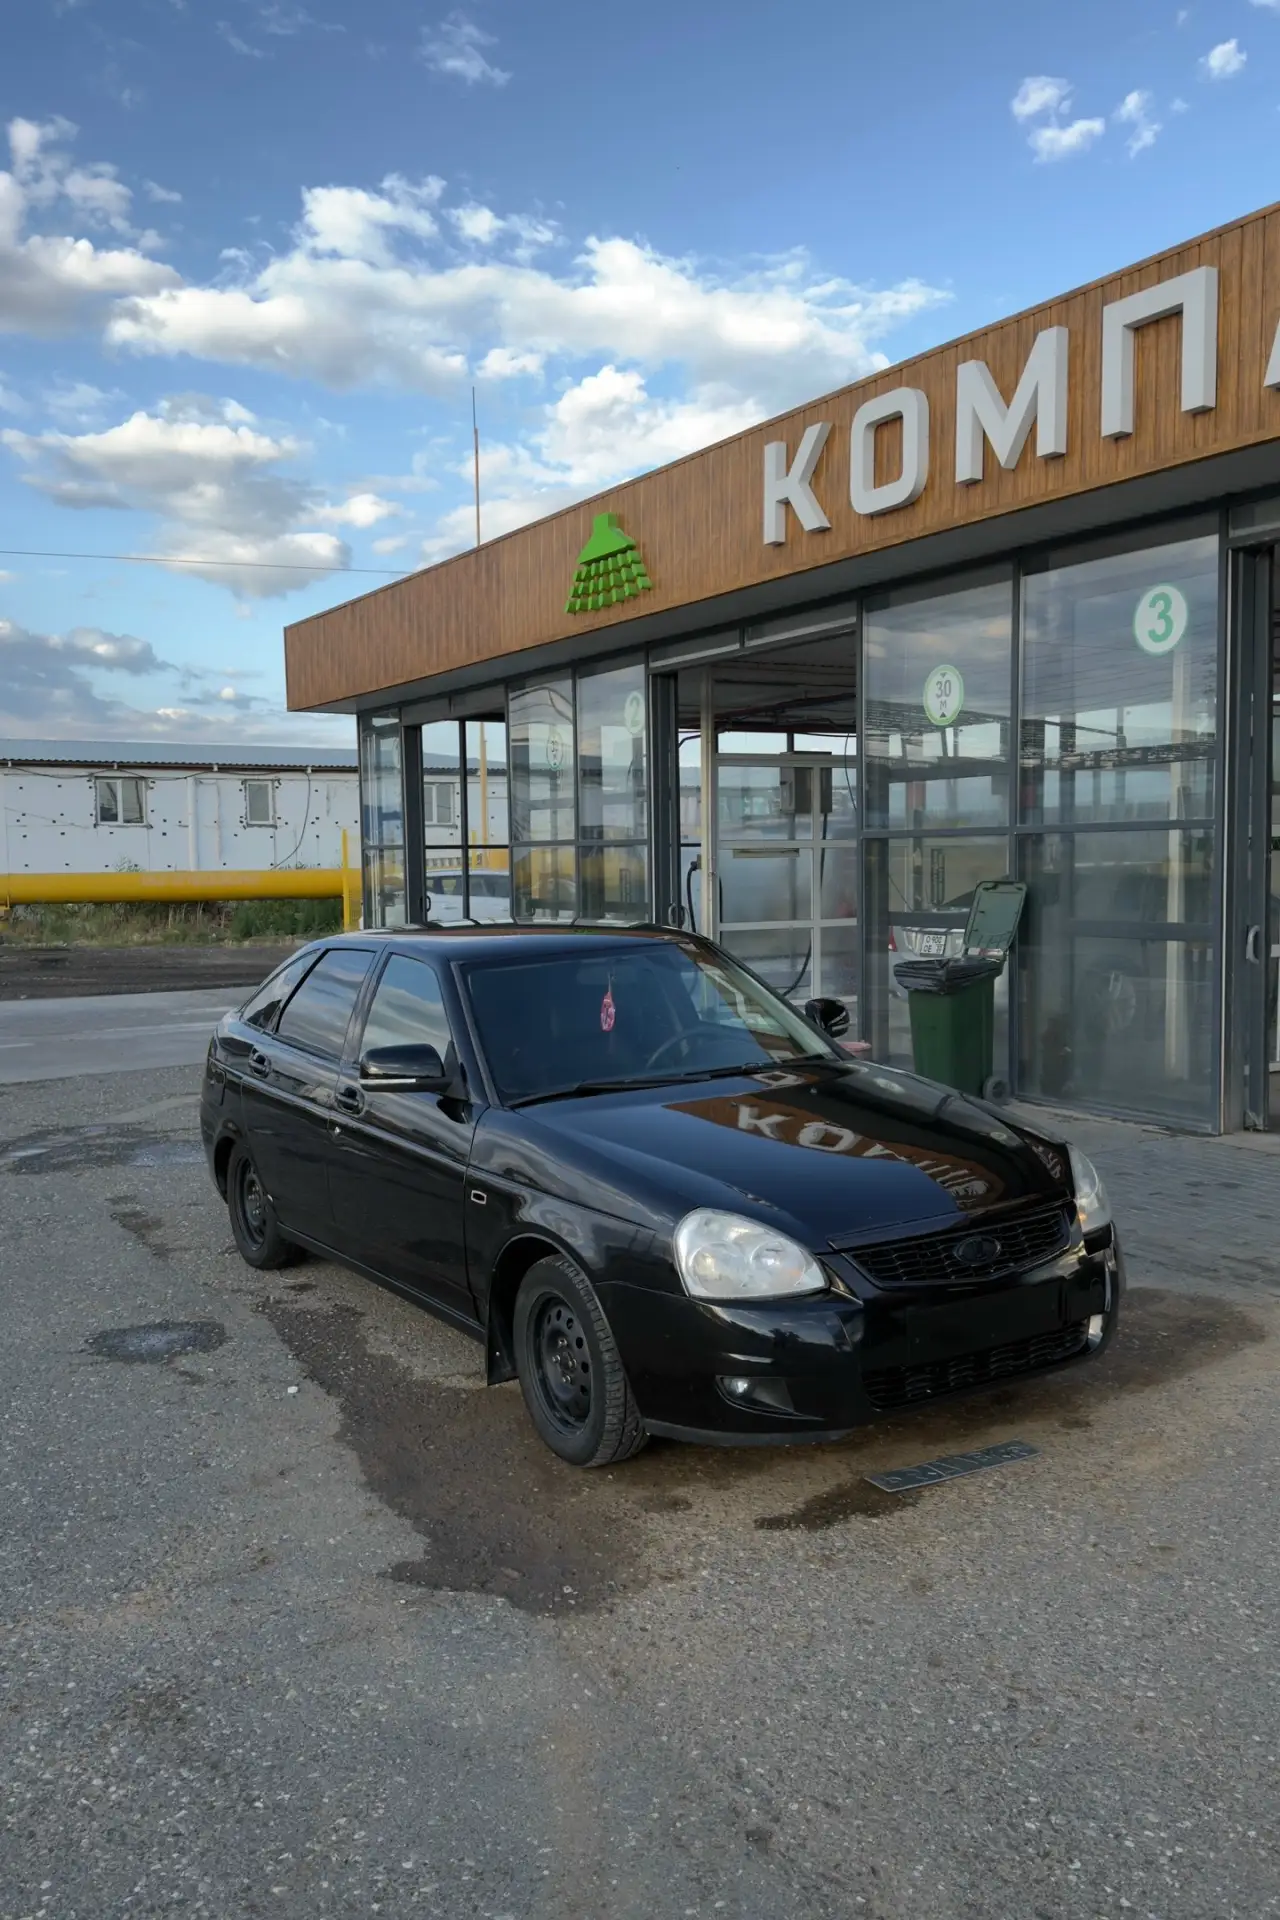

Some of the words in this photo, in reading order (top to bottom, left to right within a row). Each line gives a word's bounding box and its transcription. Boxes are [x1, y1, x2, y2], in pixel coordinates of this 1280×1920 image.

[764, 266, 1280, 546] КОМП
[1148, 591, 1174, 644] 3
[935, 679, 952, 698] 30
[629, 695, 641, 727] 2
